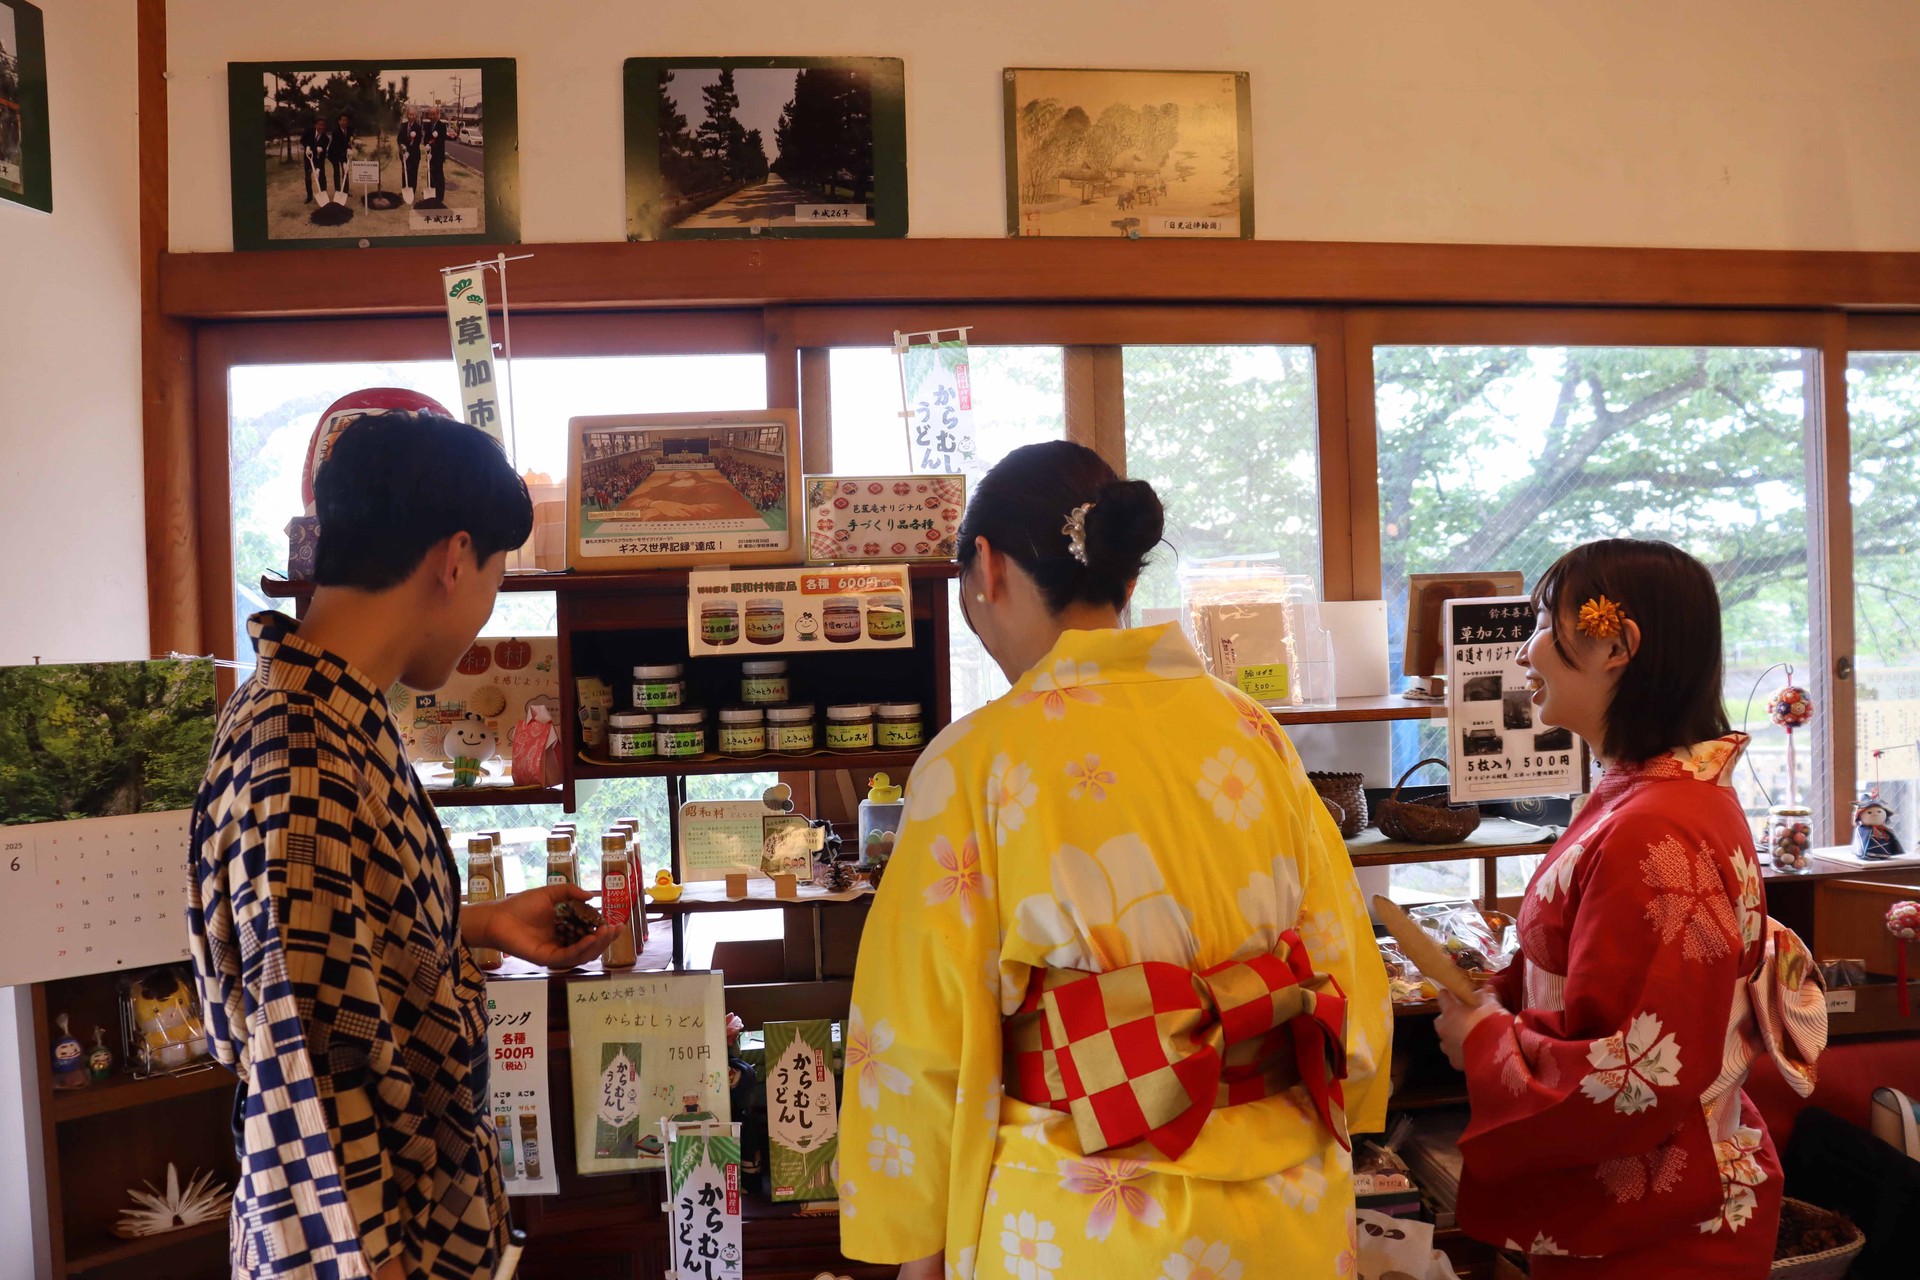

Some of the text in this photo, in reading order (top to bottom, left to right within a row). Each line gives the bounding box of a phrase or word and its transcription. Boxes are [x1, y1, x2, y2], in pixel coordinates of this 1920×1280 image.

[424, 215, 462, 224] 平成24年
[812, 209, 850, 217] 平成26年
[455, 315, 495, 427] 草加市
[916, 401, 942, 469] うどん
[933, 384, 962, 474] からむし
[848, 518, 934, 531] 手づくり品各種
[731, 581, 797, 593] 昭和村特産品
[806, 578, 829, 590] 各種
[838, 577, 877, 589] 600円
[1468, 757, 1512, 772] 5枚入り
[685, 805, 724, 819] 昭和村
[10, 856, 20, 872] 6
[487, 1000, 496, 1009] 品
[604, 1012, 704, 1028] からむしうどん
[503, 1032, 526, 1045] 各種
[495, 1047, 534, 1060] 500円
[669, 1045, 711, 1060] 750円
[501, 1061, 527, 1071] (税込)
[604, 1071, 615, 1107] うどん
[615, 1062, 628, 1111] からむし
[793, 1053, 813, 1129] からむし
[776, 1068, 796, 1124] うどん
[726, 1164, 739, 1215] 昭和村特産品
[680, 1197, 702, 1273] うどん
[697, 1182, 724, 1280] からむし
